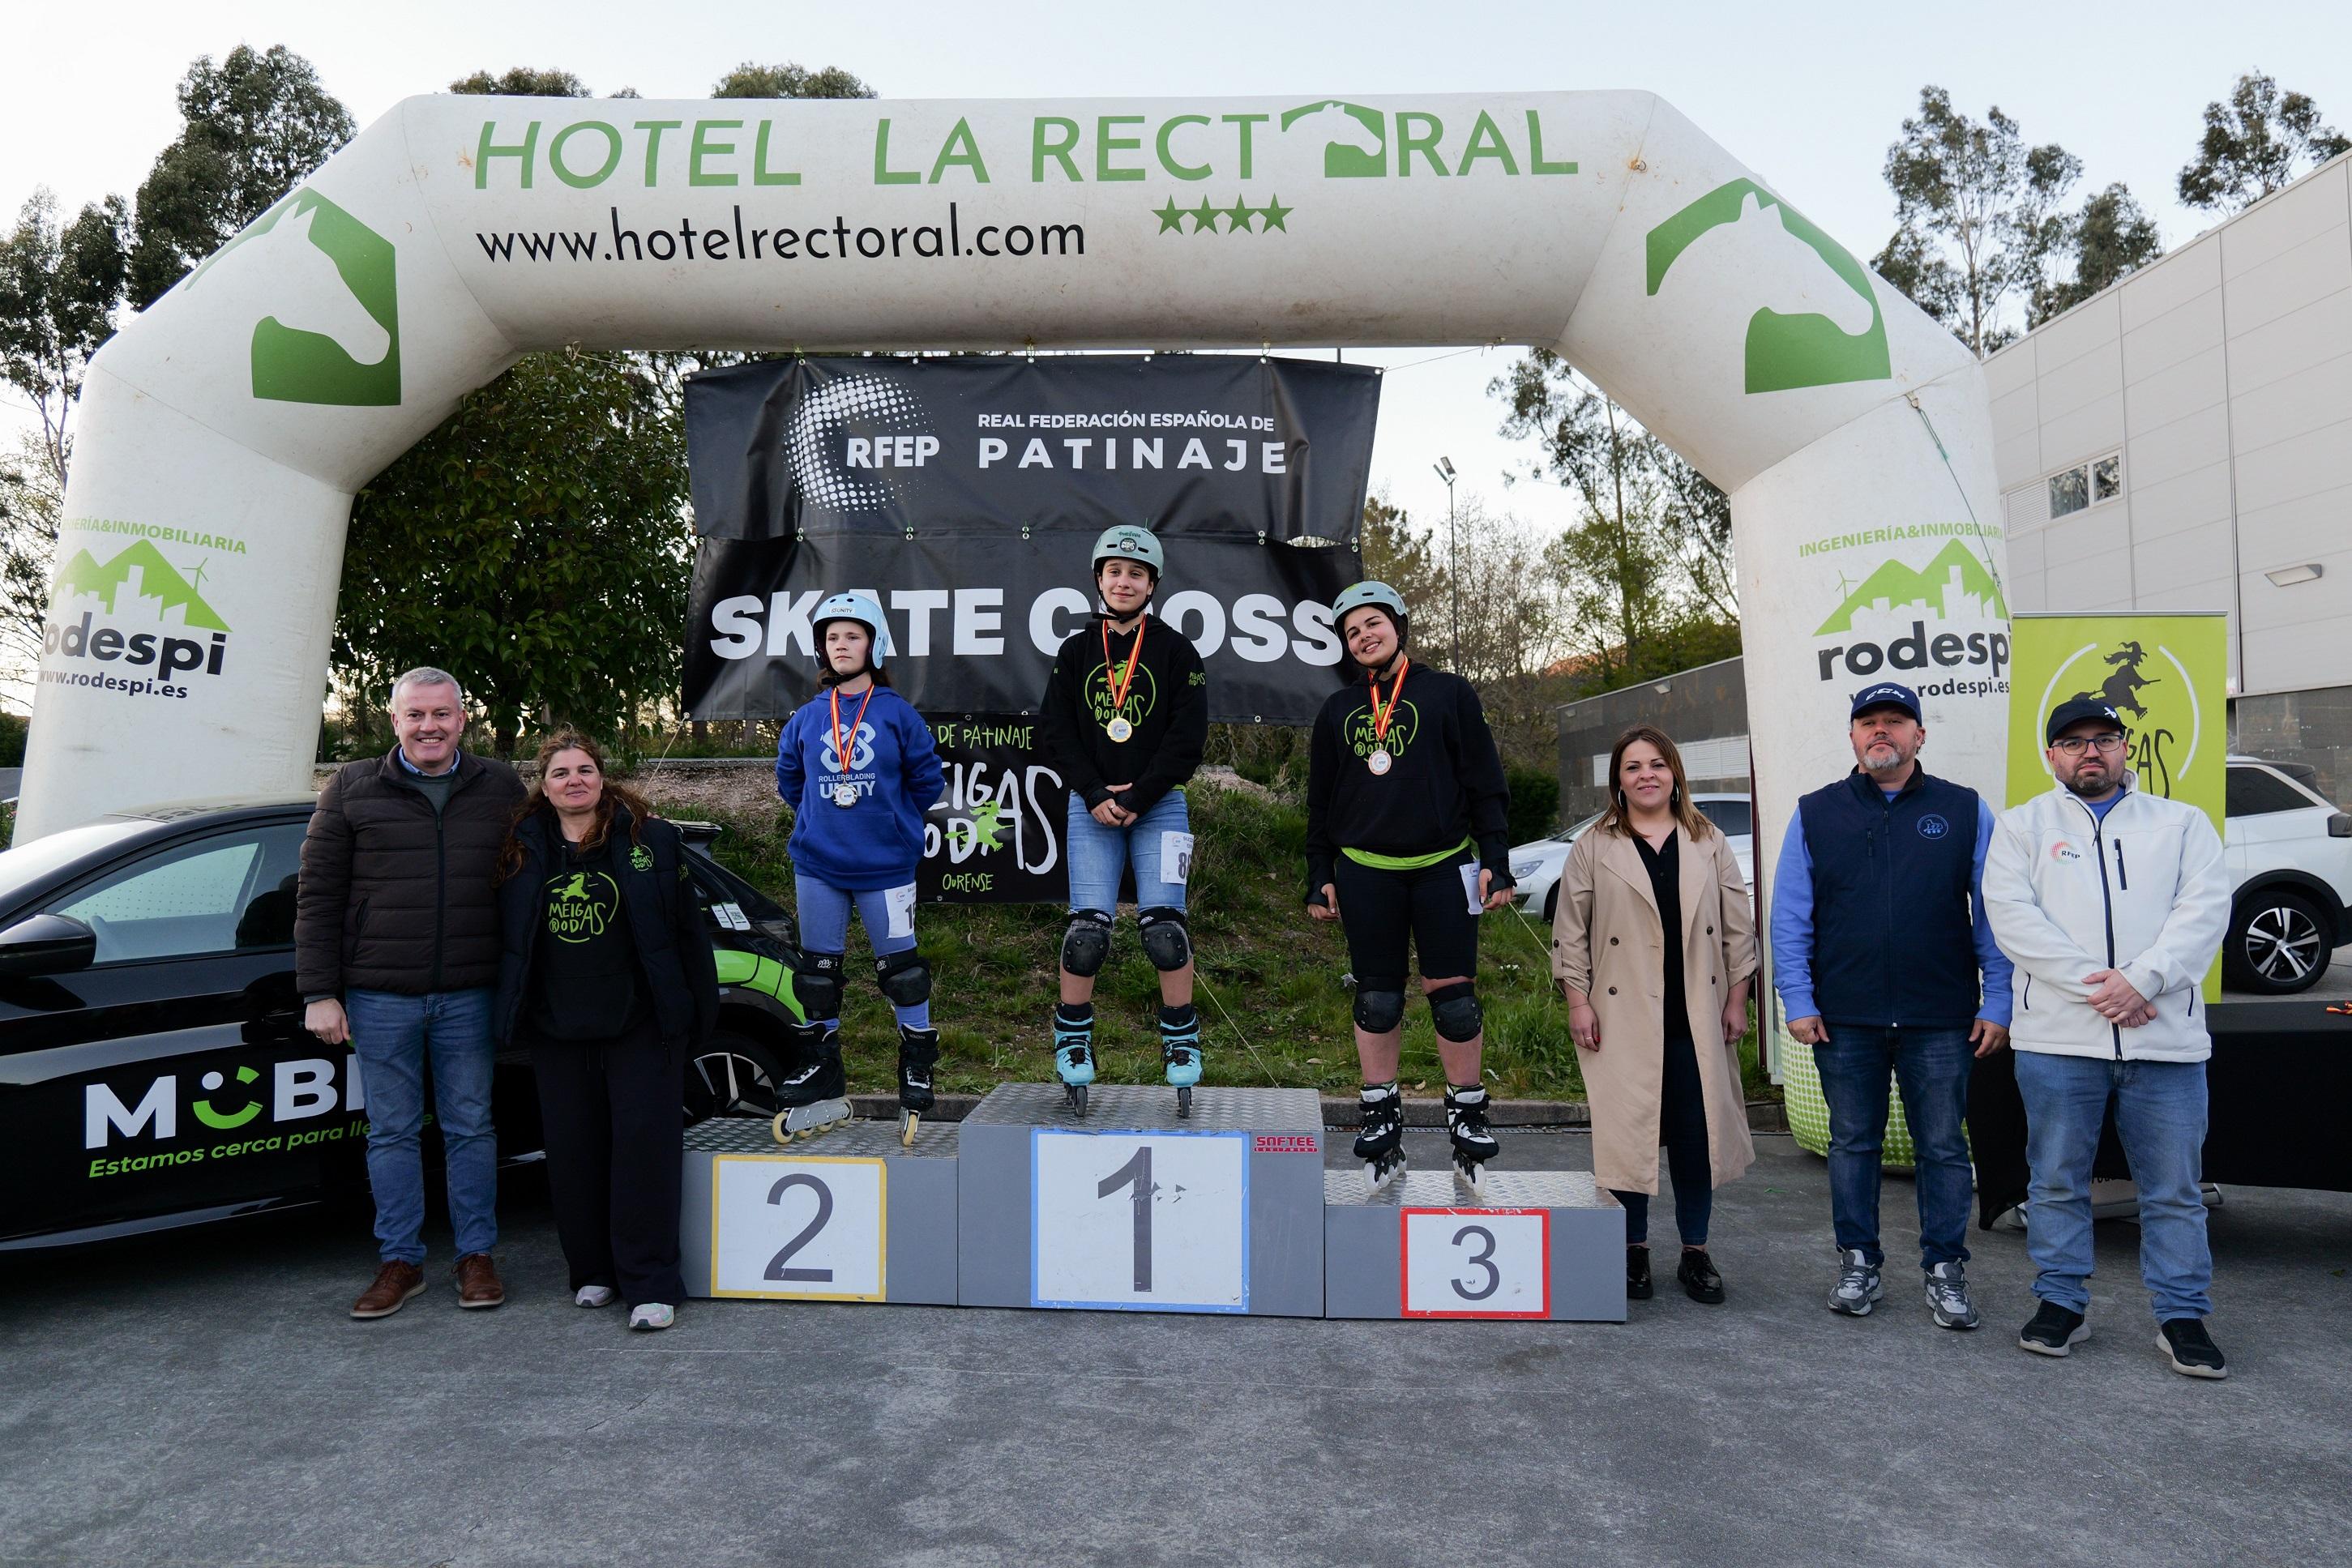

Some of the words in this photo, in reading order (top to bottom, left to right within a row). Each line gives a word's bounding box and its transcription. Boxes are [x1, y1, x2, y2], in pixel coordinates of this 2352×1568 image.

[474, 119, 802, 190] HOTEL
[874, 116, 990, 185] LA
[1031, 100, 1579, 183] RECTRAL
[476, 202, 1085, 263] www.hotelrectoral.com
[977, 413, 1025, 428] REAL
[1028, 410, 1146, 429] FEDERACIÓN
[1150, 409, 1247, 429] ESPAÑOLA
[1251, 416, 1275, 432] DE
[846, 435, 940, 468] RFEP
[978, 438, 1287, 474] PATINAJE
[45, 612, 227, 682] odespi
[1028, 587, 1344, 667] COSS
[938, 724, 958, 748] DE
[964, 724, 1035, 750] PATINAJE
[2125, 728, 2175, 800] GAS
[819, 772, 876, 783] ROLLERBLADING
[819, 780, 876, 799] UTY
[942, 873, 994, 893] OURENSE
[88, 1147, 205, 1178] Estamos
[211, 1137, 281, 1159] cerca
[287, 1124, 344, 1151] para
[763, 1173, 835, 1284] 2
[1097, 1145, 1152, 1294] 1
[1449, 1224, 1502, 1301] 3
